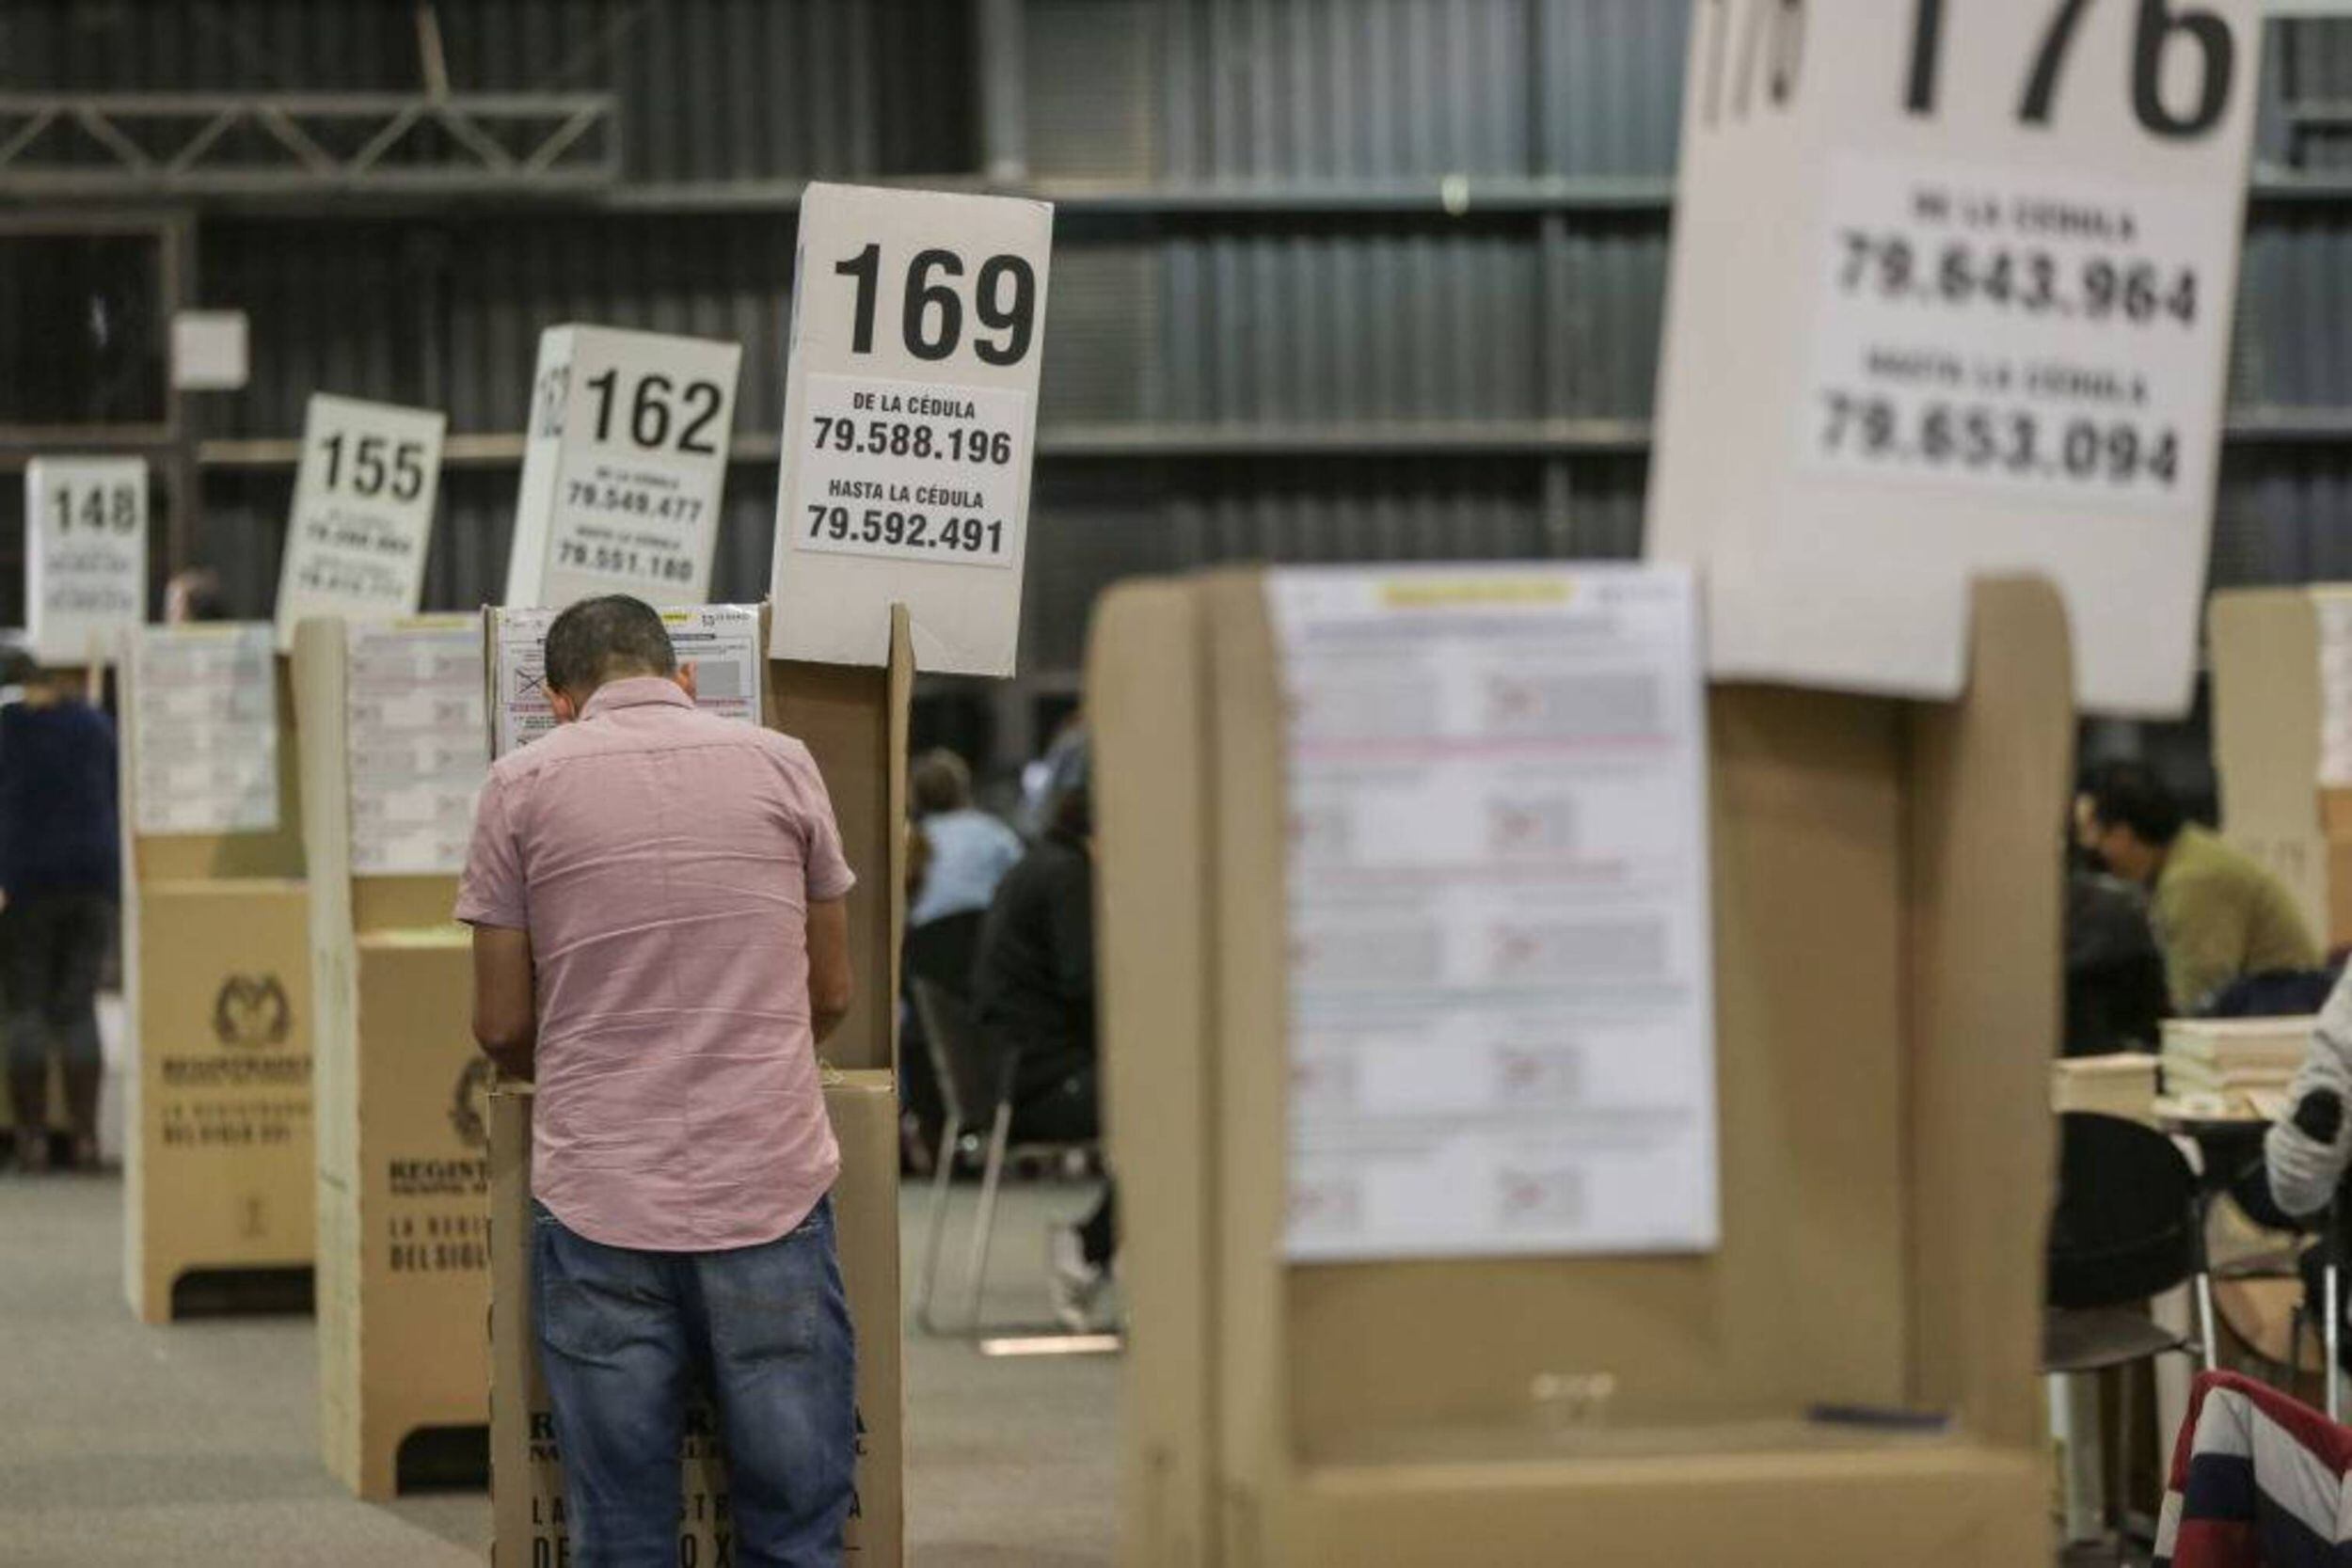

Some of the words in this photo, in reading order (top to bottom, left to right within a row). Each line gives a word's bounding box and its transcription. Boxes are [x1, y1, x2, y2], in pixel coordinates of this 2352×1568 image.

[834, 243, 1036, 366] 169
[587, 368, 722, 453] 162
[853, 392, 874, 409] DE
[881, 395, 901, 412] LA
[907, 395, 975, 419] CÉDULA
[814, 417, 1012, 465] 79.588.196
[323, 433, 425, 502] 155
[56, 487, 136, 533] 148
[829, 480, 882, 500] HASTA
[889, 484, 910, 502] LA
[915, 484, 983, 509] CÉDULA
[807, 504, 1002, 553] 79.592.491
